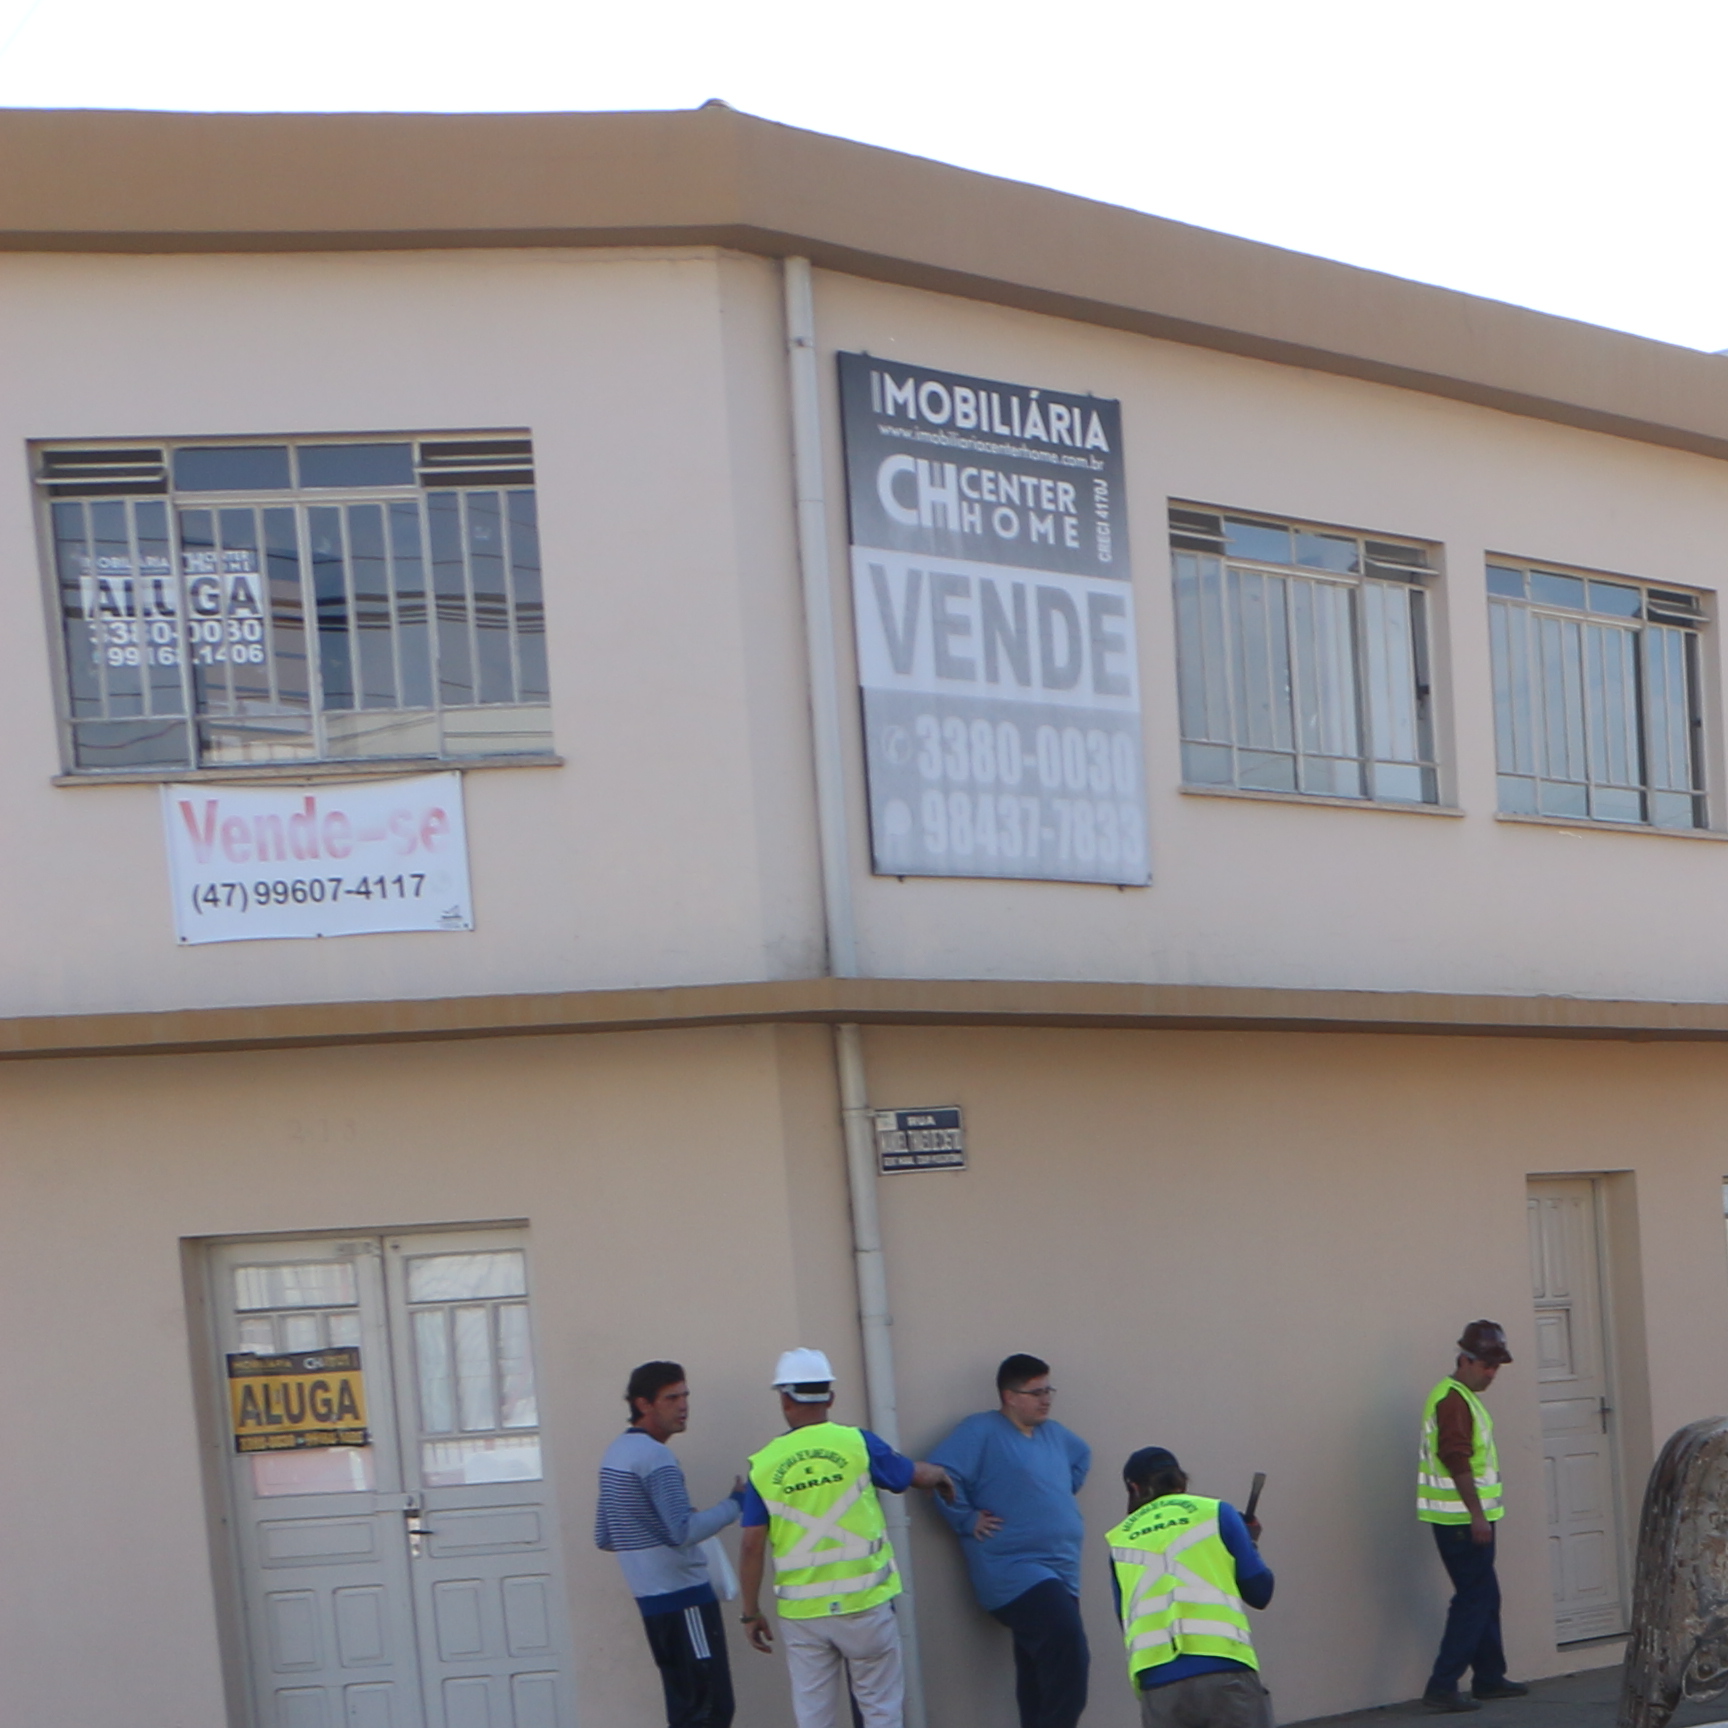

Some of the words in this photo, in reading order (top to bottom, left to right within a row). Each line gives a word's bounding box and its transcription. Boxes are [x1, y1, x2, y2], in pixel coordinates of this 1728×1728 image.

[871, 370, 1110, 452] IMOBILIÁRIA
[877, 453, 960, 532] CH
[959, 466, 1077, 515] CENTER
[961, 500, 1080, 549] HOME
[868, 562, 1132, 697] VENDE
[915, 713, 1138, 796] 3380-0030
[178, 795, 448, 864] Vende-se
[907, 1115, 937, 1127] RUA
[238, 1378, 360, 1427] ALUGA
[784, 1473, 844, 1494] OBRAS
[1128, 1517, 1190, 1541] OBRAS
